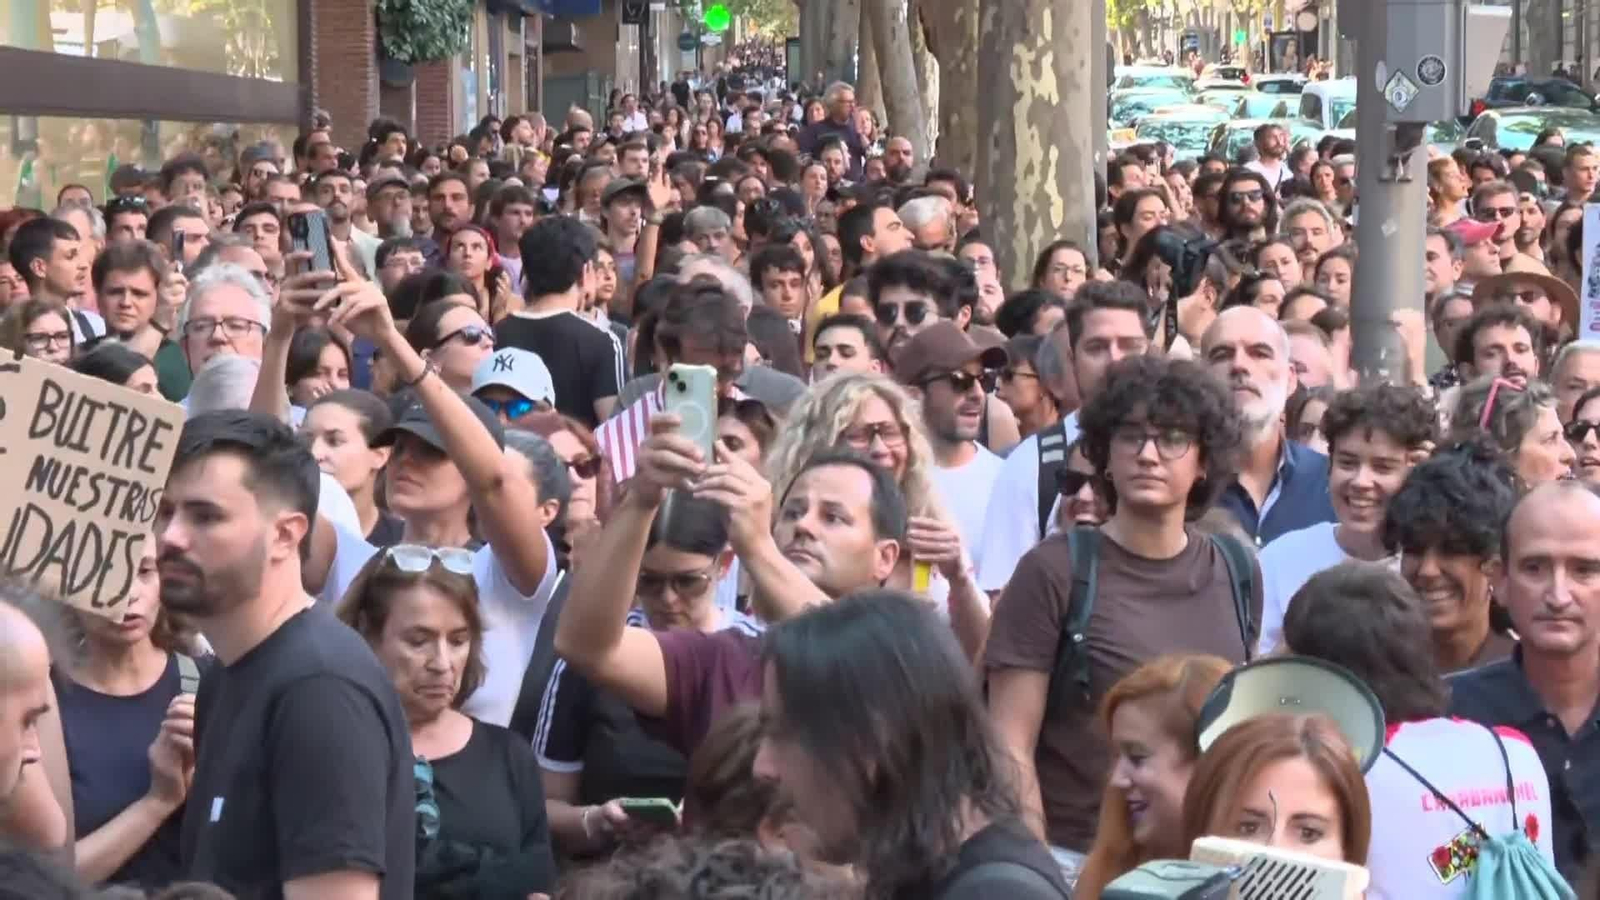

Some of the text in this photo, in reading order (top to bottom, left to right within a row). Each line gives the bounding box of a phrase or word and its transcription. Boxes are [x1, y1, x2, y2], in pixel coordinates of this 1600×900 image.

[492, 353, 515, 372] NY
[29, 378, 173, 473] BUITRE
[25, 454, 163, 525] NUESTRAS
